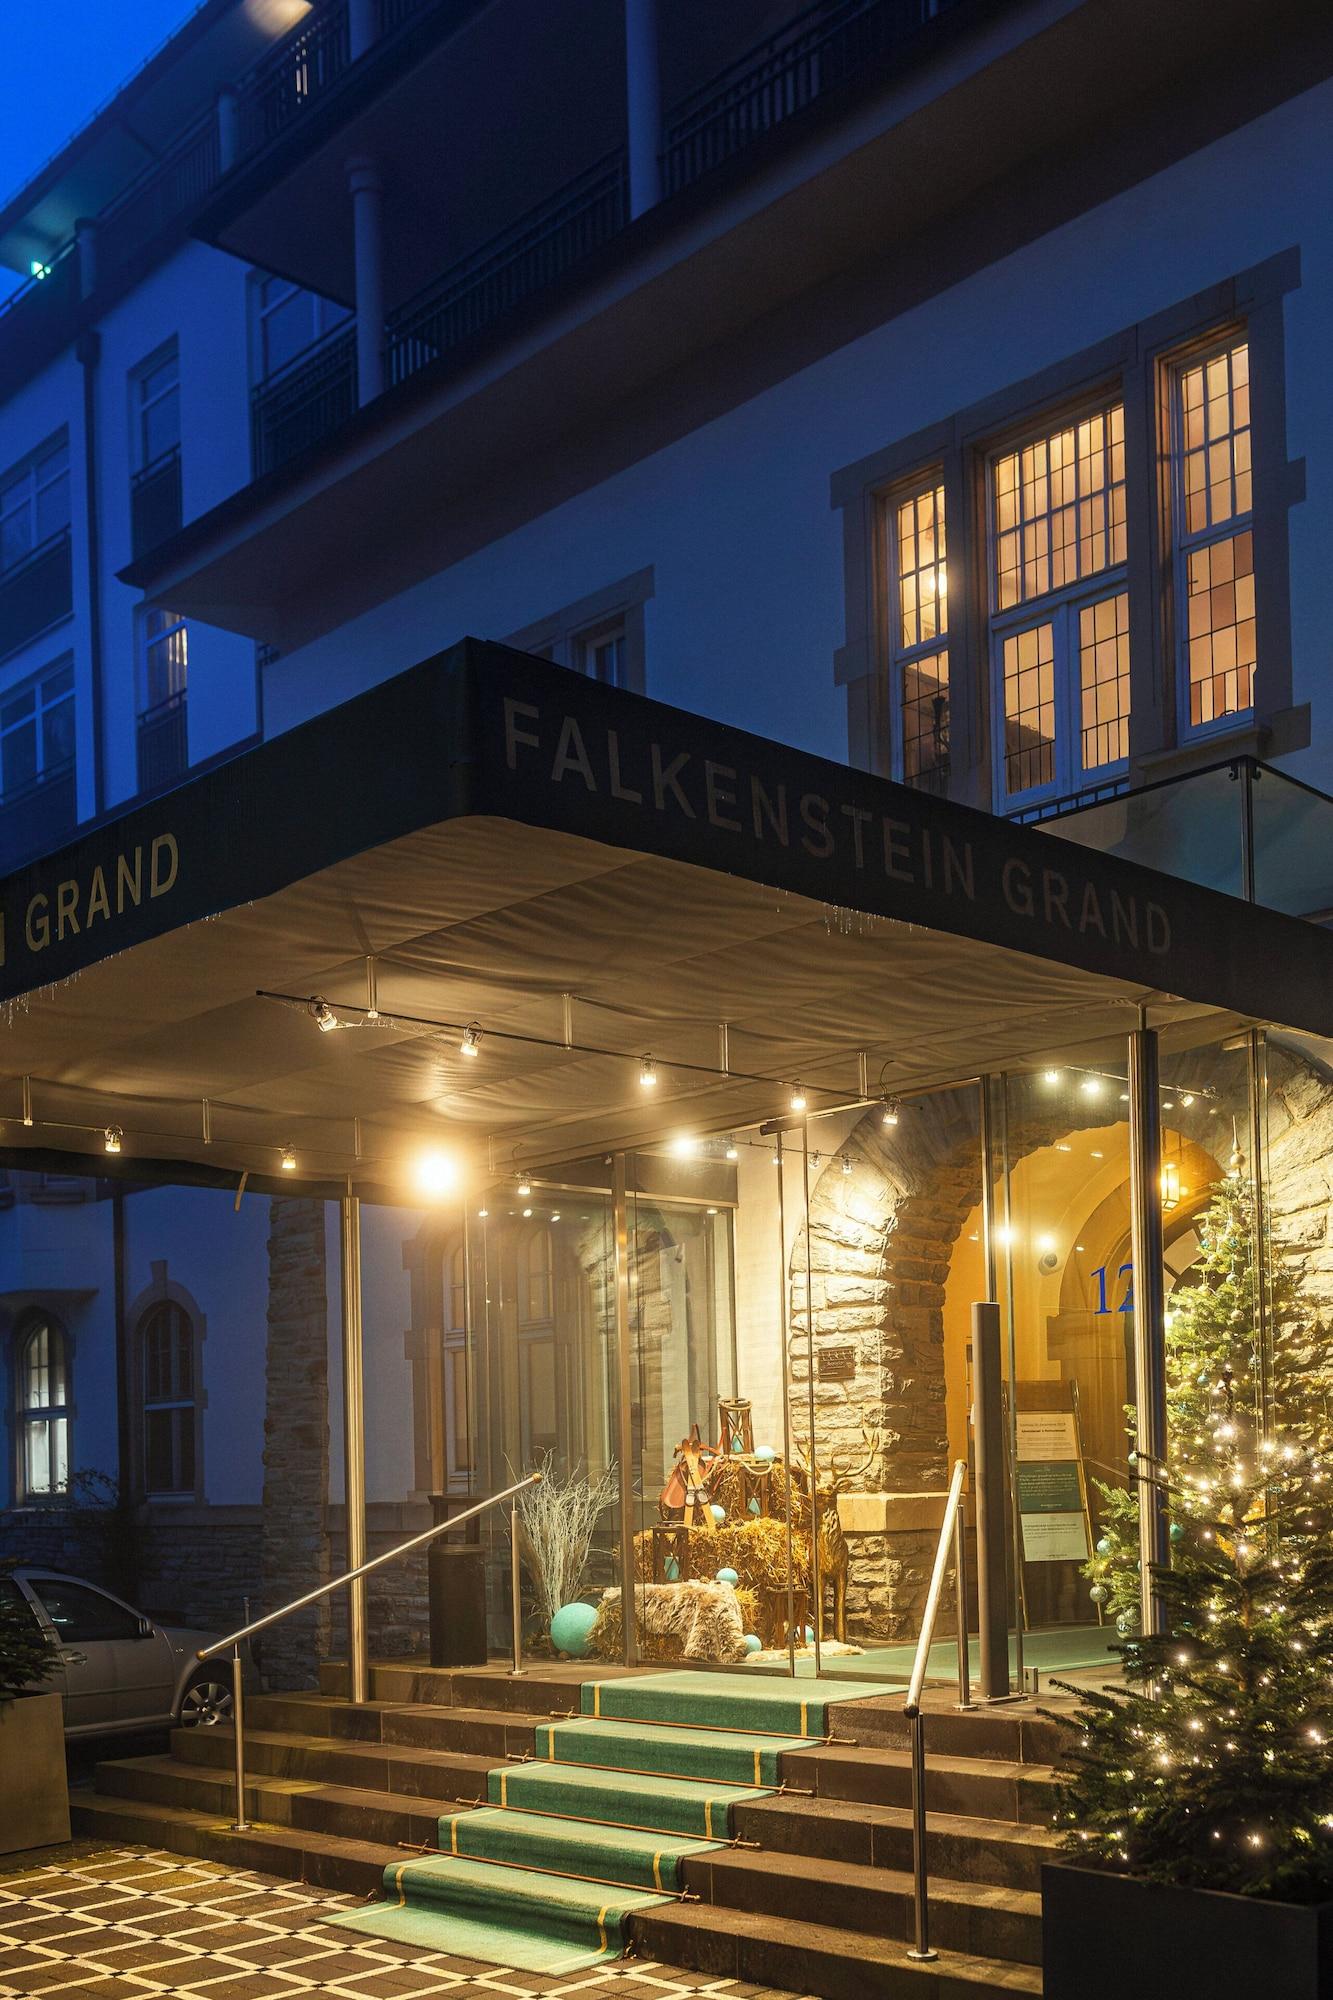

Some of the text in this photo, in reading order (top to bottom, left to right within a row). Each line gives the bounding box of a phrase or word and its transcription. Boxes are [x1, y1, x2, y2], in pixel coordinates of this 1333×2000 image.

[25, 832, 179, 952] GRAND
[503, 696, 1172, 953] FALKENSTEIN GRAND
